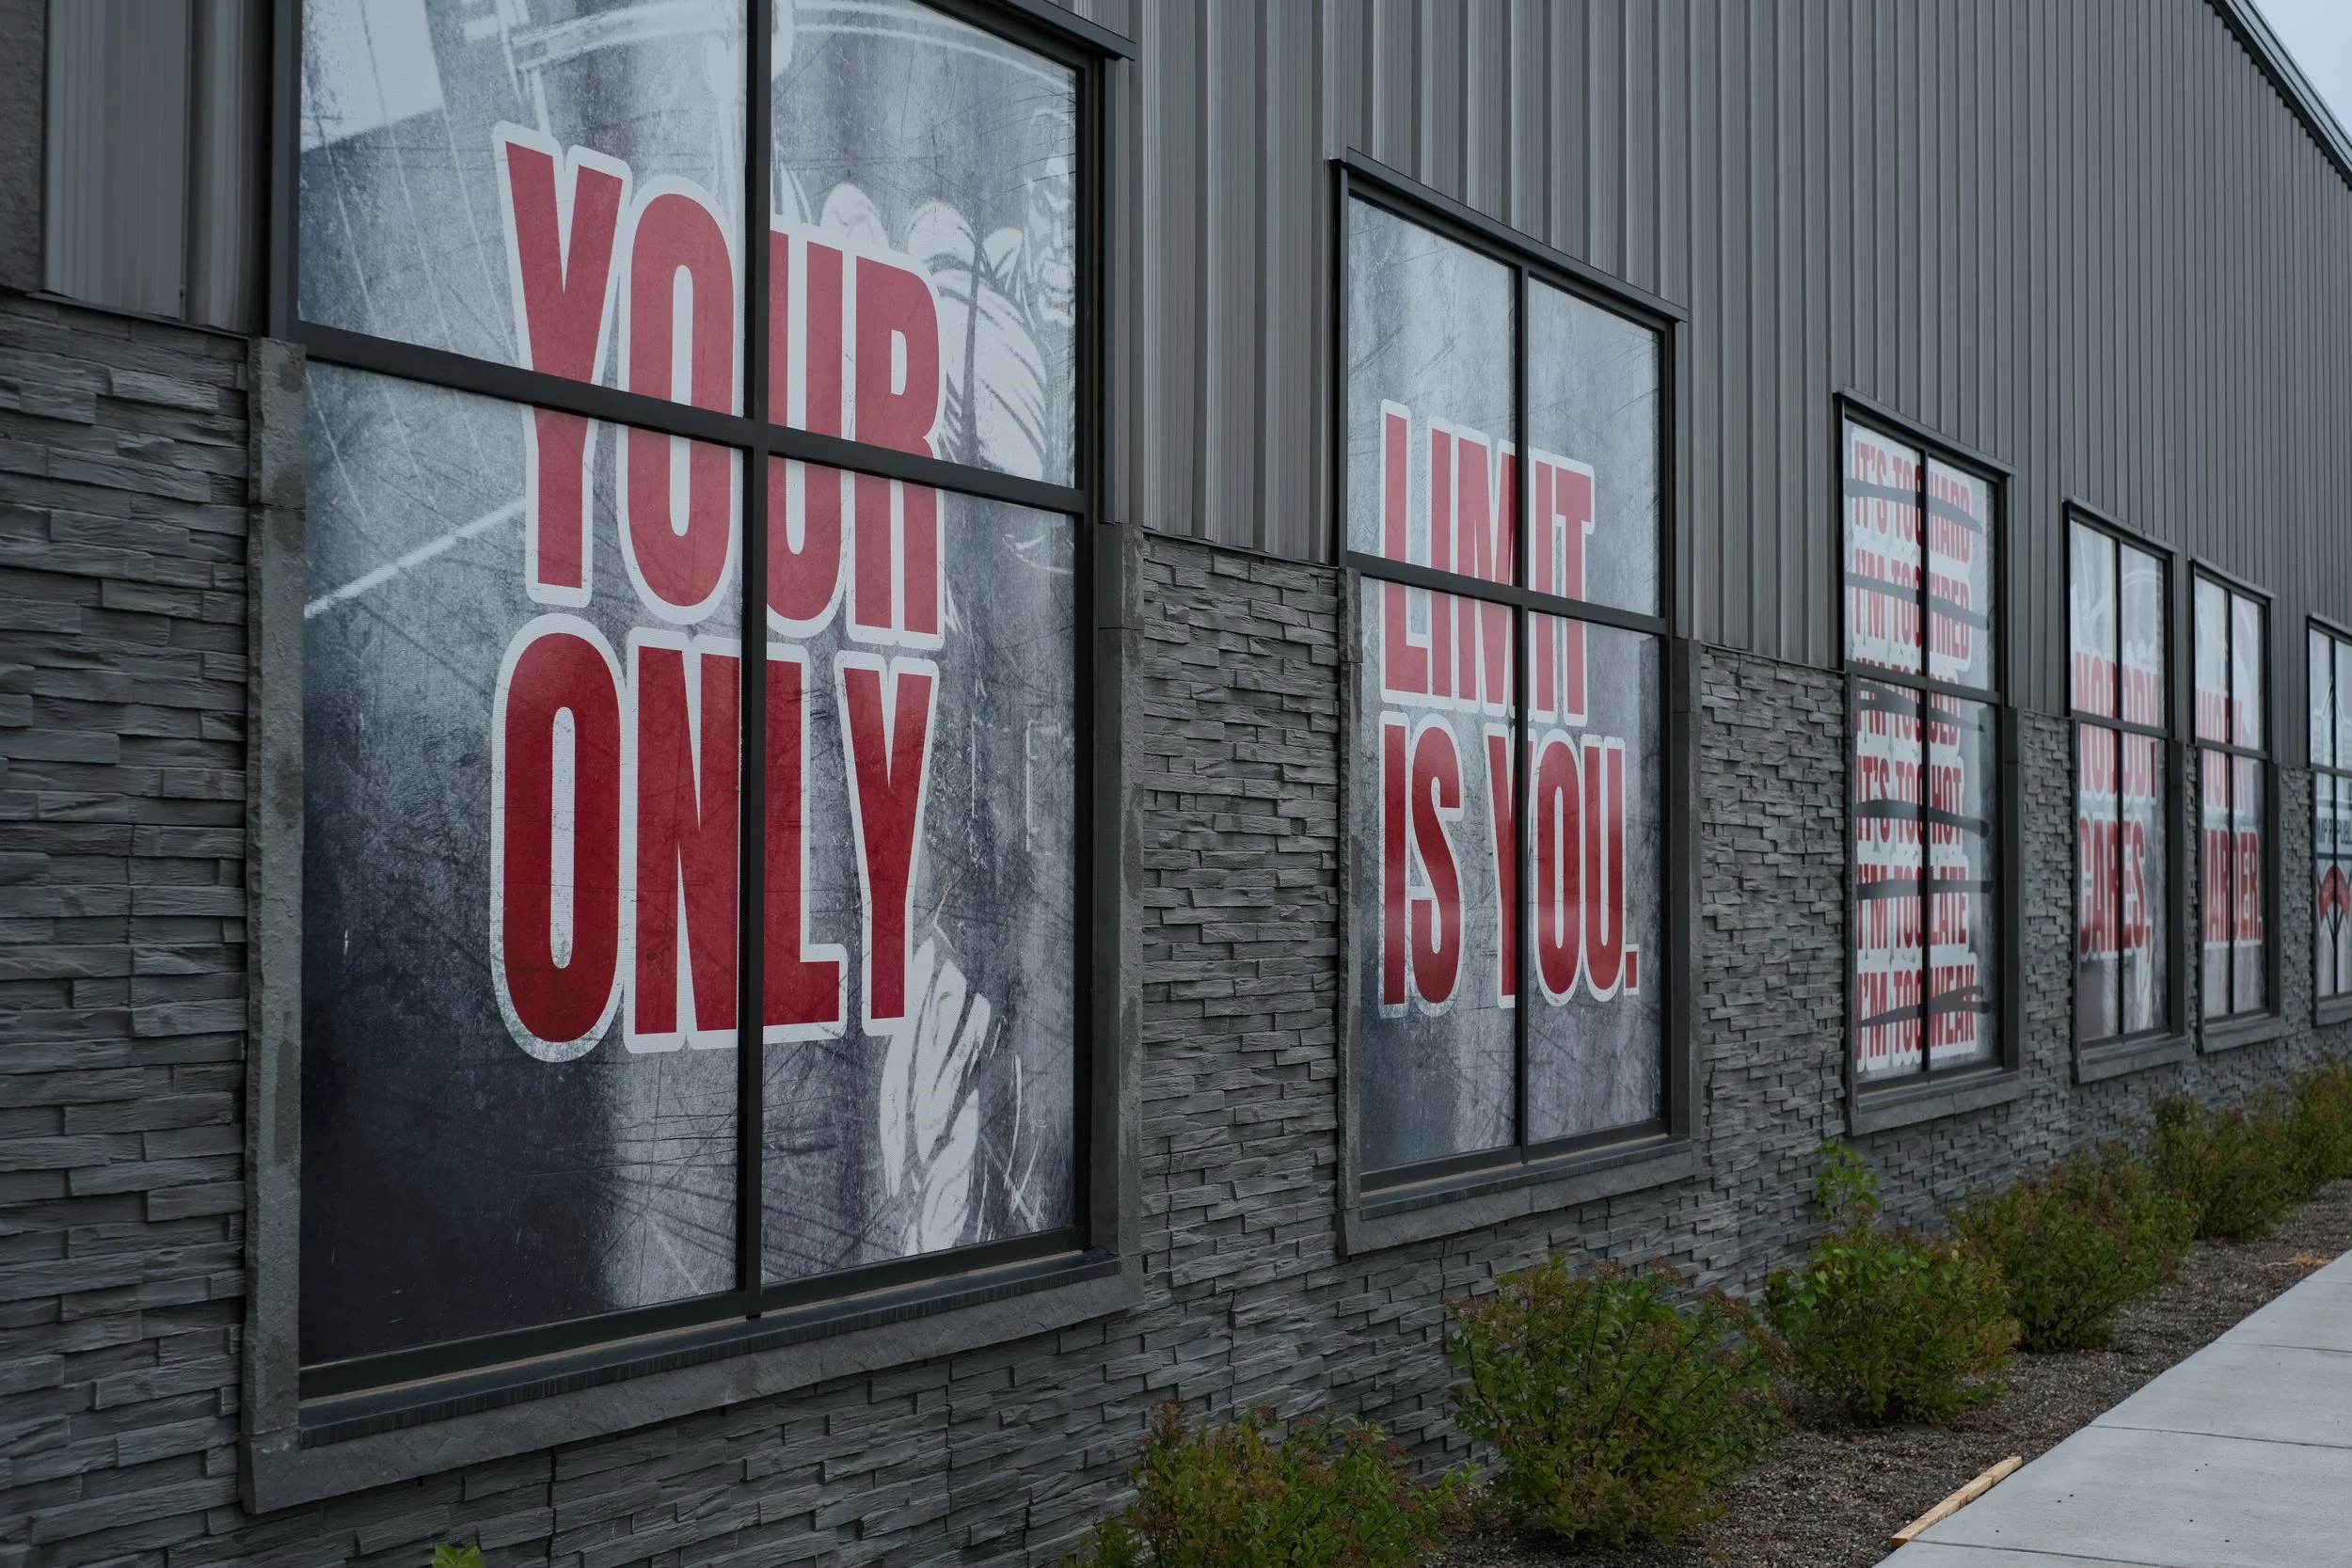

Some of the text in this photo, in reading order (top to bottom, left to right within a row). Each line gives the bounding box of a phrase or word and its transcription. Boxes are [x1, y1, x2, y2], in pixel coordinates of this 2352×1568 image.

[504, 141, 941, 635] YOUR
[1384, 412, 1592, 715] LIMIT
[1854, 439, 1971, 564] IT'S TOO HARD
[1855, 547, 1970, 660] I'M TOO TIRED
[1892, 663, 1925, 743] TOO
[1929, 672, 1959, 747] OLD
[2074, 650, 2158, 799] NOBODY
[502, 631, 934, 1043] ONLY
[1383, 723, 1638, 1006] IS YOU.
[1857, 754, 1963, 847] IT'S TOO HOT
[1857, 863, 1967, 950] I'M TOO LATE
[2079, 816, 2153, 965] CARES,
[1855, 963, 1976, 1060] I'M TOO WEAK
